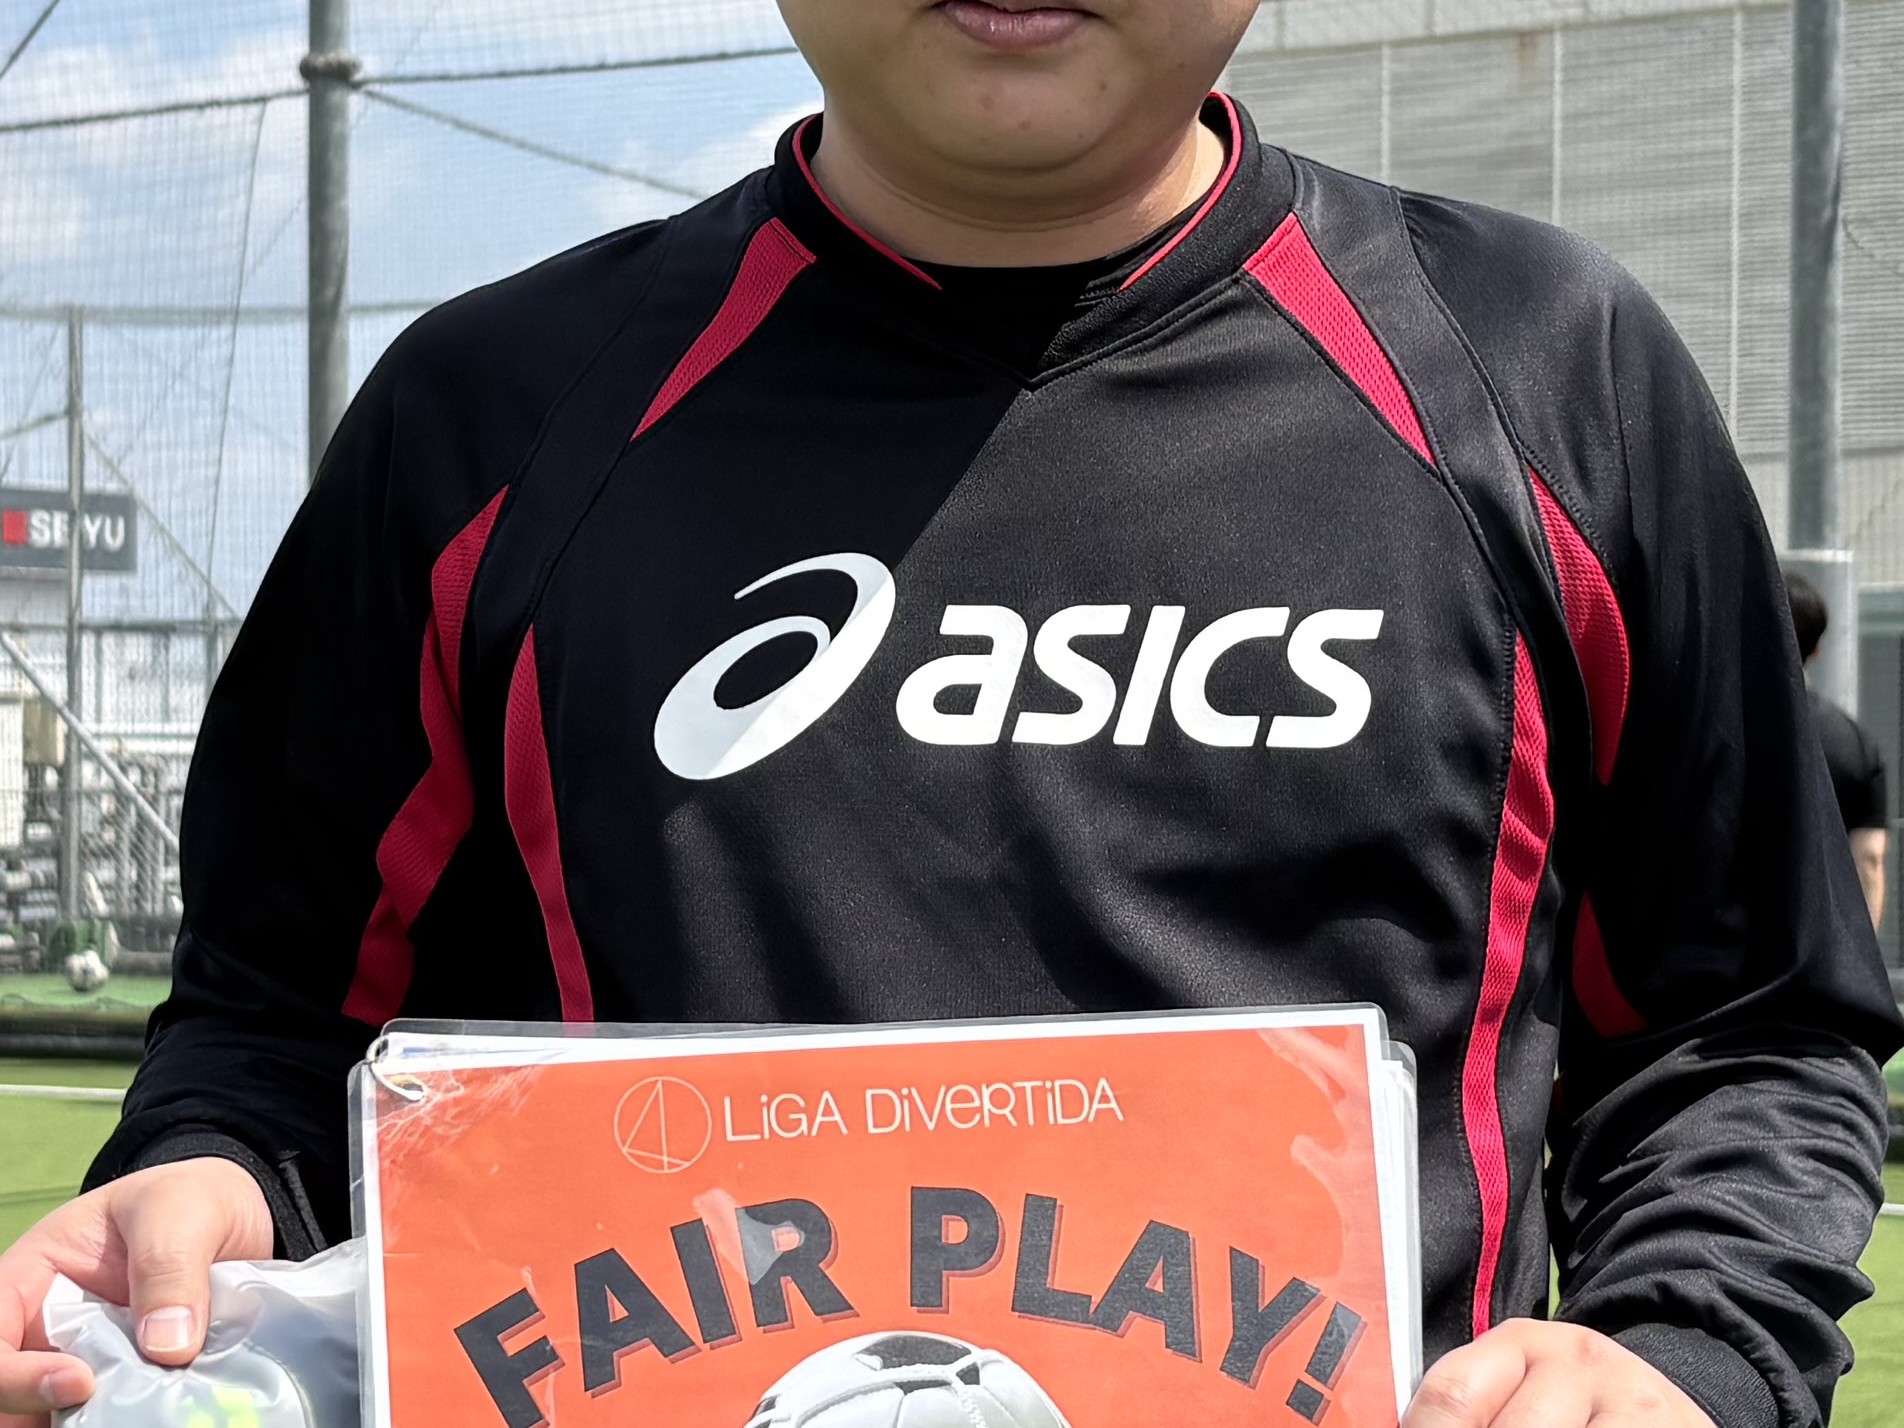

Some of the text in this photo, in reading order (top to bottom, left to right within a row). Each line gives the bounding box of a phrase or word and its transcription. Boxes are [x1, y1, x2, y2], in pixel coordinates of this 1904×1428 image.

[30, 509, 126, 552] SEYU
[896, 604, 1384, 748] asics
[908, 1184, 1367, 1426] PLAY!
